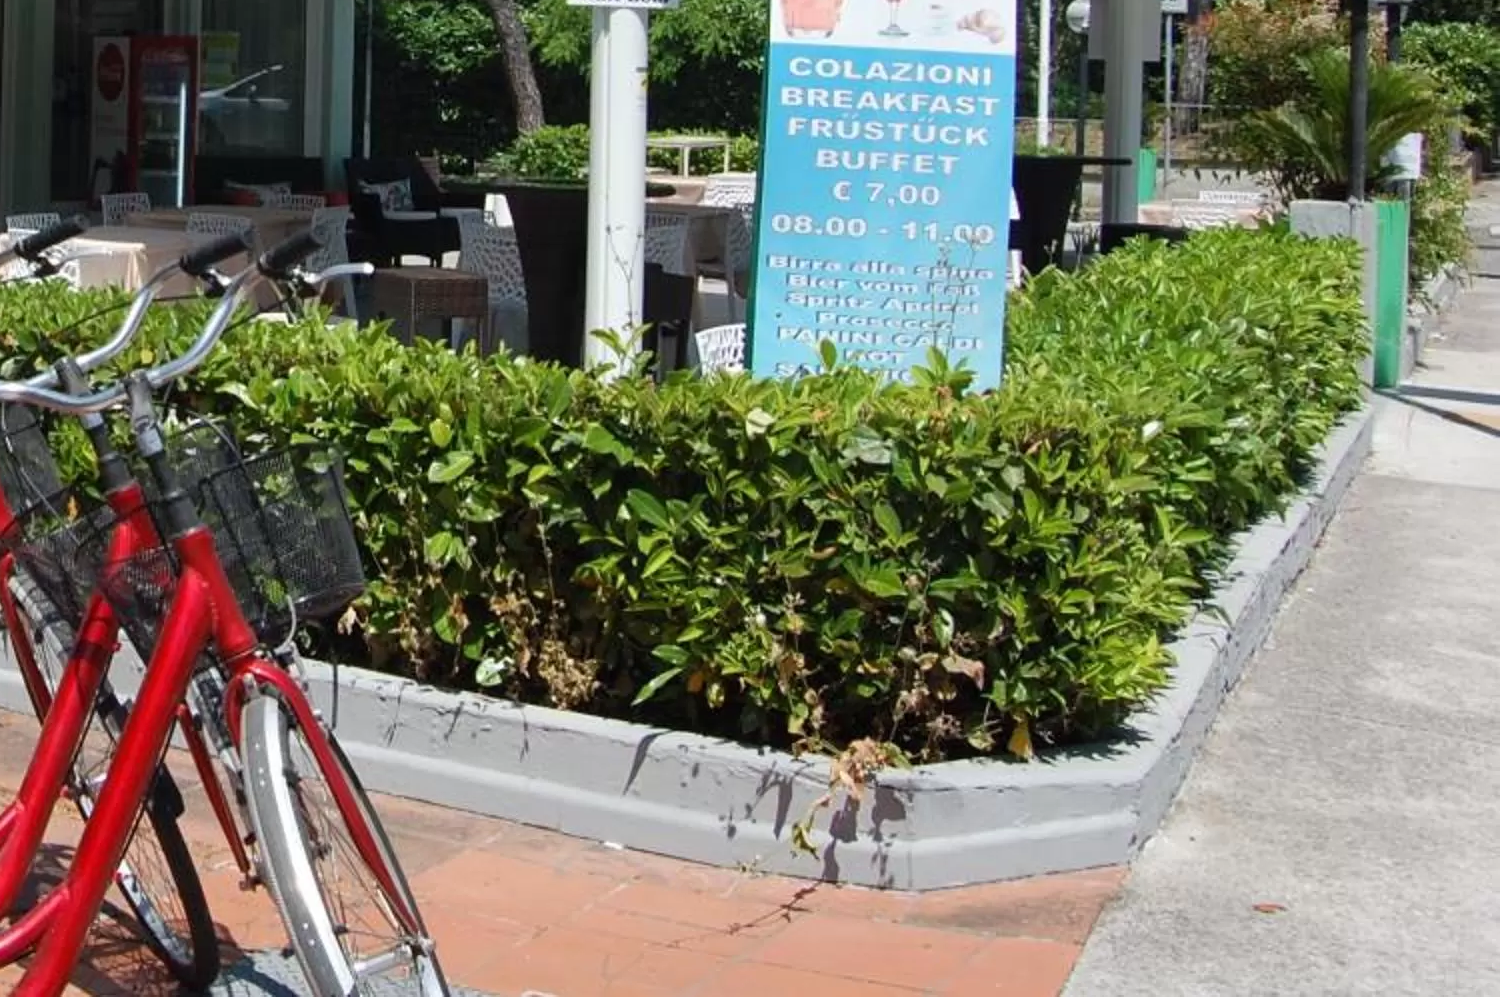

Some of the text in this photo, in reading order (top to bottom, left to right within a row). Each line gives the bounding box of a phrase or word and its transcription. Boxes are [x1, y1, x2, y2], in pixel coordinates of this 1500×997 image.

[789, 56, 992, 86] COLAZIONI
[780, 86, 1001, 116] BREAKFAST
[816, 148, 960, 175] BUFFET
[833, 180, 852, 201] €
[771, 213, 868, 237] 08.00
[903, 220, 996, 244] 11.00
